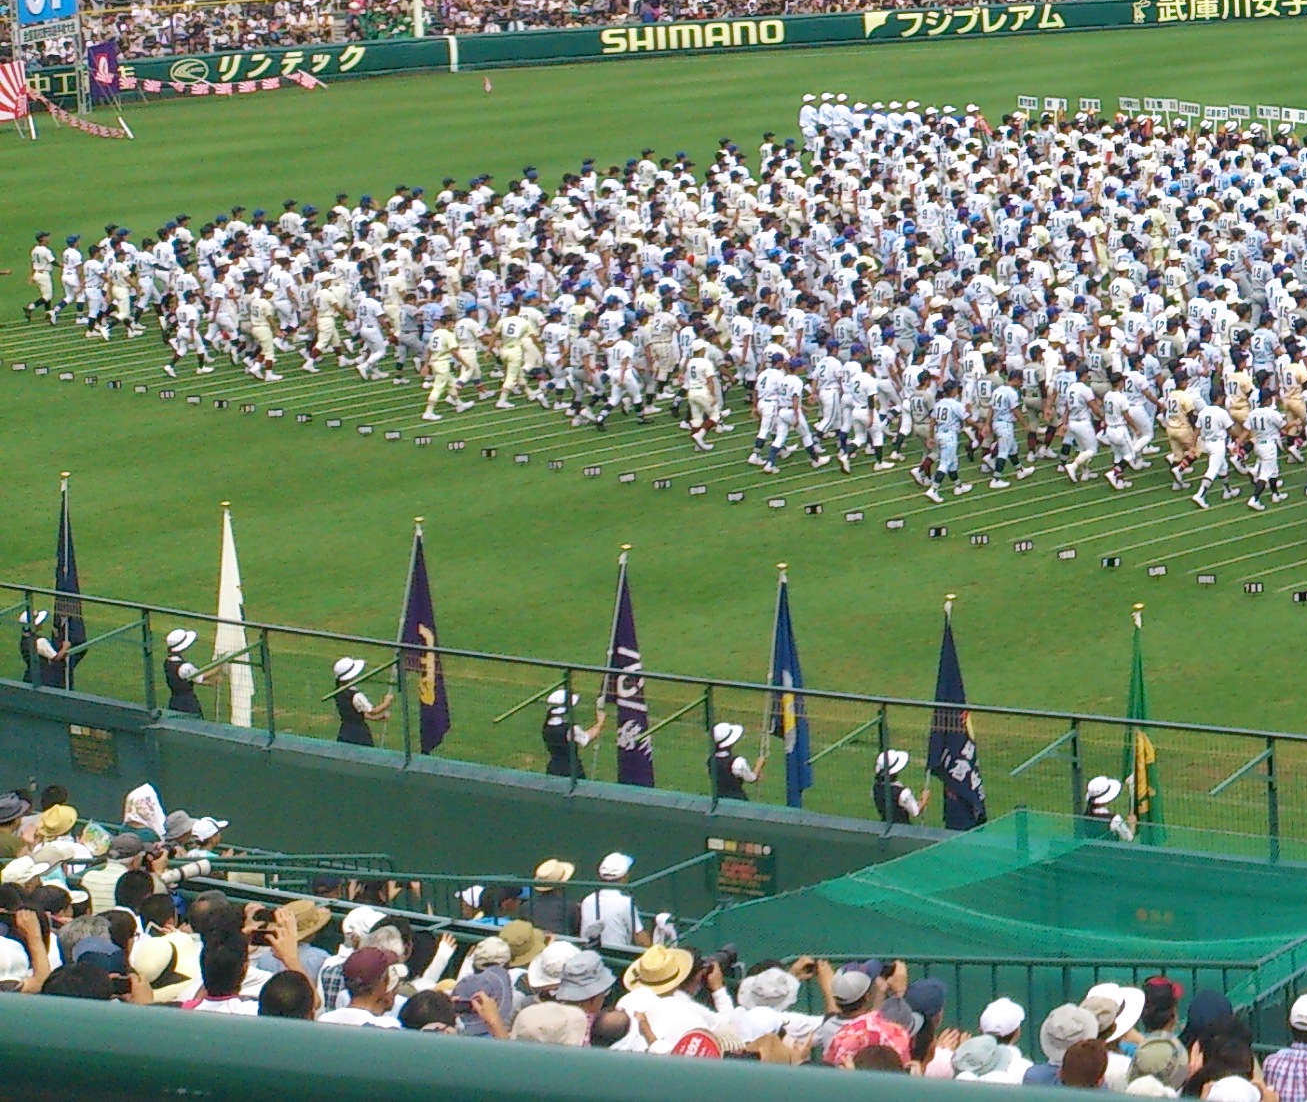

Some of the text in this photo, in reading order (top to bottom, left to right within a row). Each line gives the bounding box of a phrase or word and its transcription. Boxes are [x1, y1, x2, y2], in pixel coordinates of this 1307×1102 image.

[600, 19, 785, 55] SHIMANO
[897, 3, 1067, 37] フジプレアム
[217, 45, 366, 83] リンテック
[1287, 372, 1292, 385] 6
